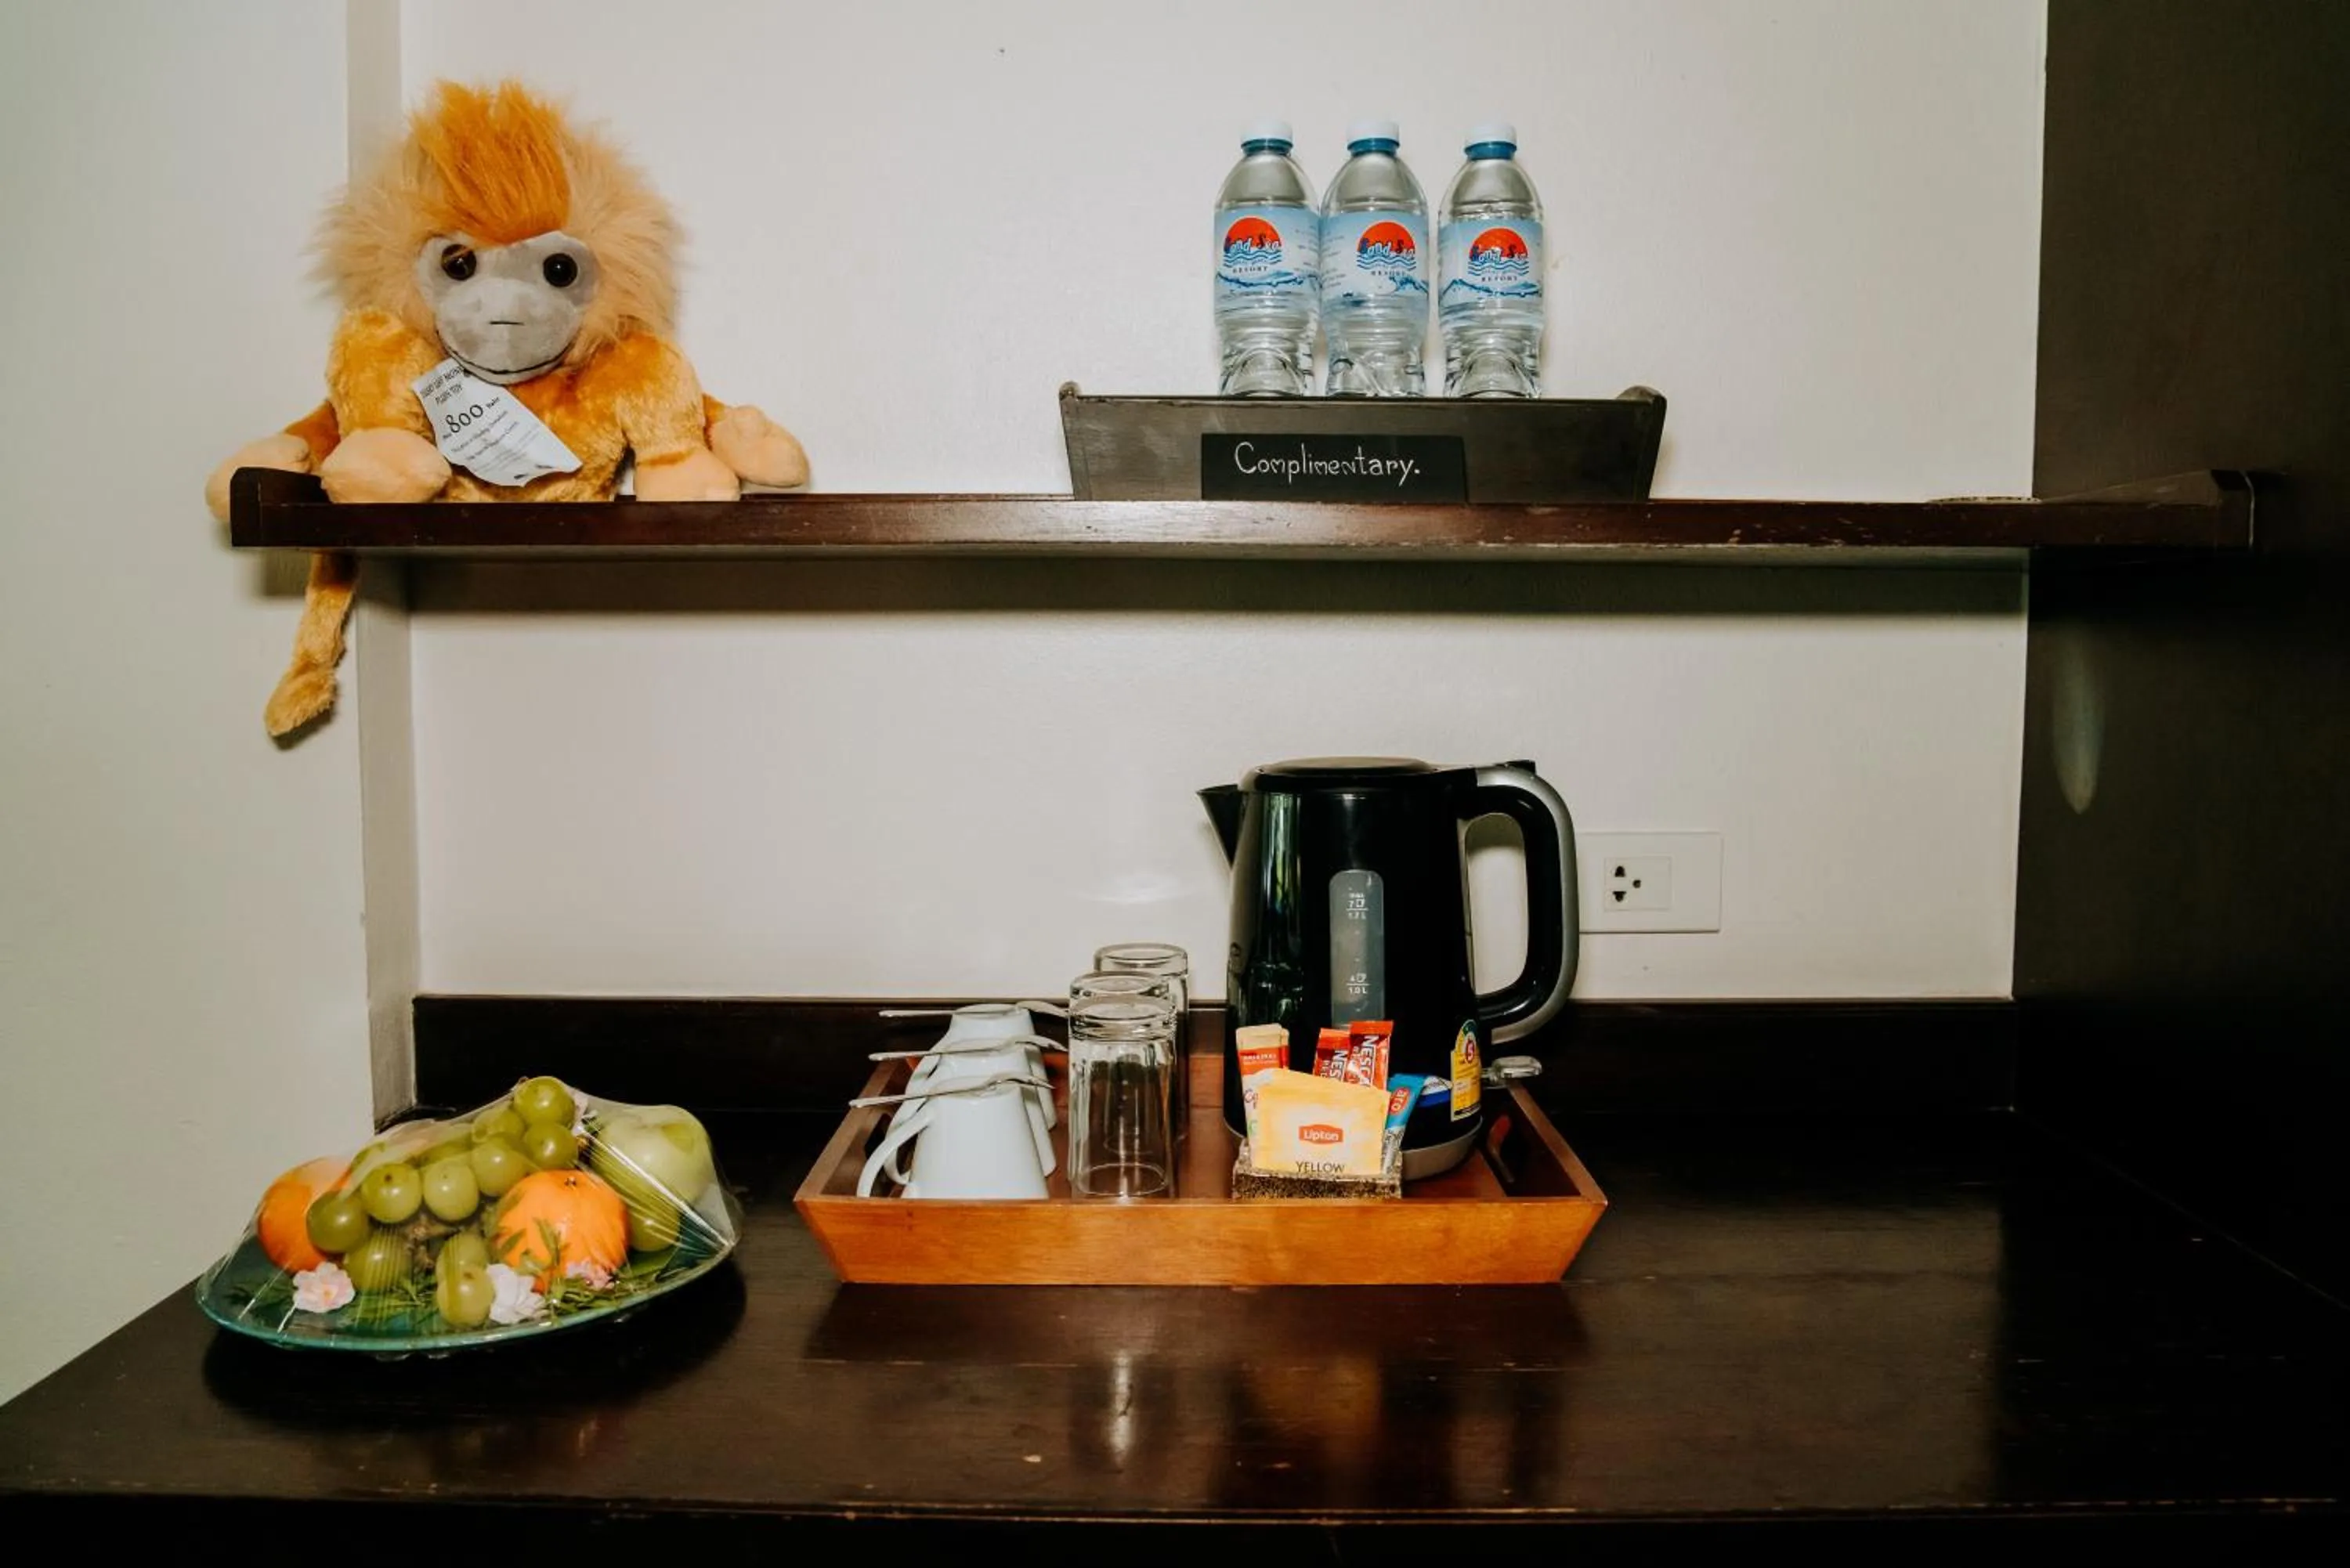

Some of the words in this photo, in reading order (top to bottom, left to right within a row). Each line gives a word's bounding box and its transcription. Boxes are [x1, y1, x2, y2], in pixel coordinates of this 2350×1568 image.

[445, 403, 484, 434] 800
[1235, 441, 1421, 487] Complimentary.
[1329, 1050, 1349, 1078] NES
[1359, 1035, 1379, 1087] NESCA
[1303, 1129, 1339, 1141] Lipton
[1296, 1161, 1345, 1172] YELLOW
